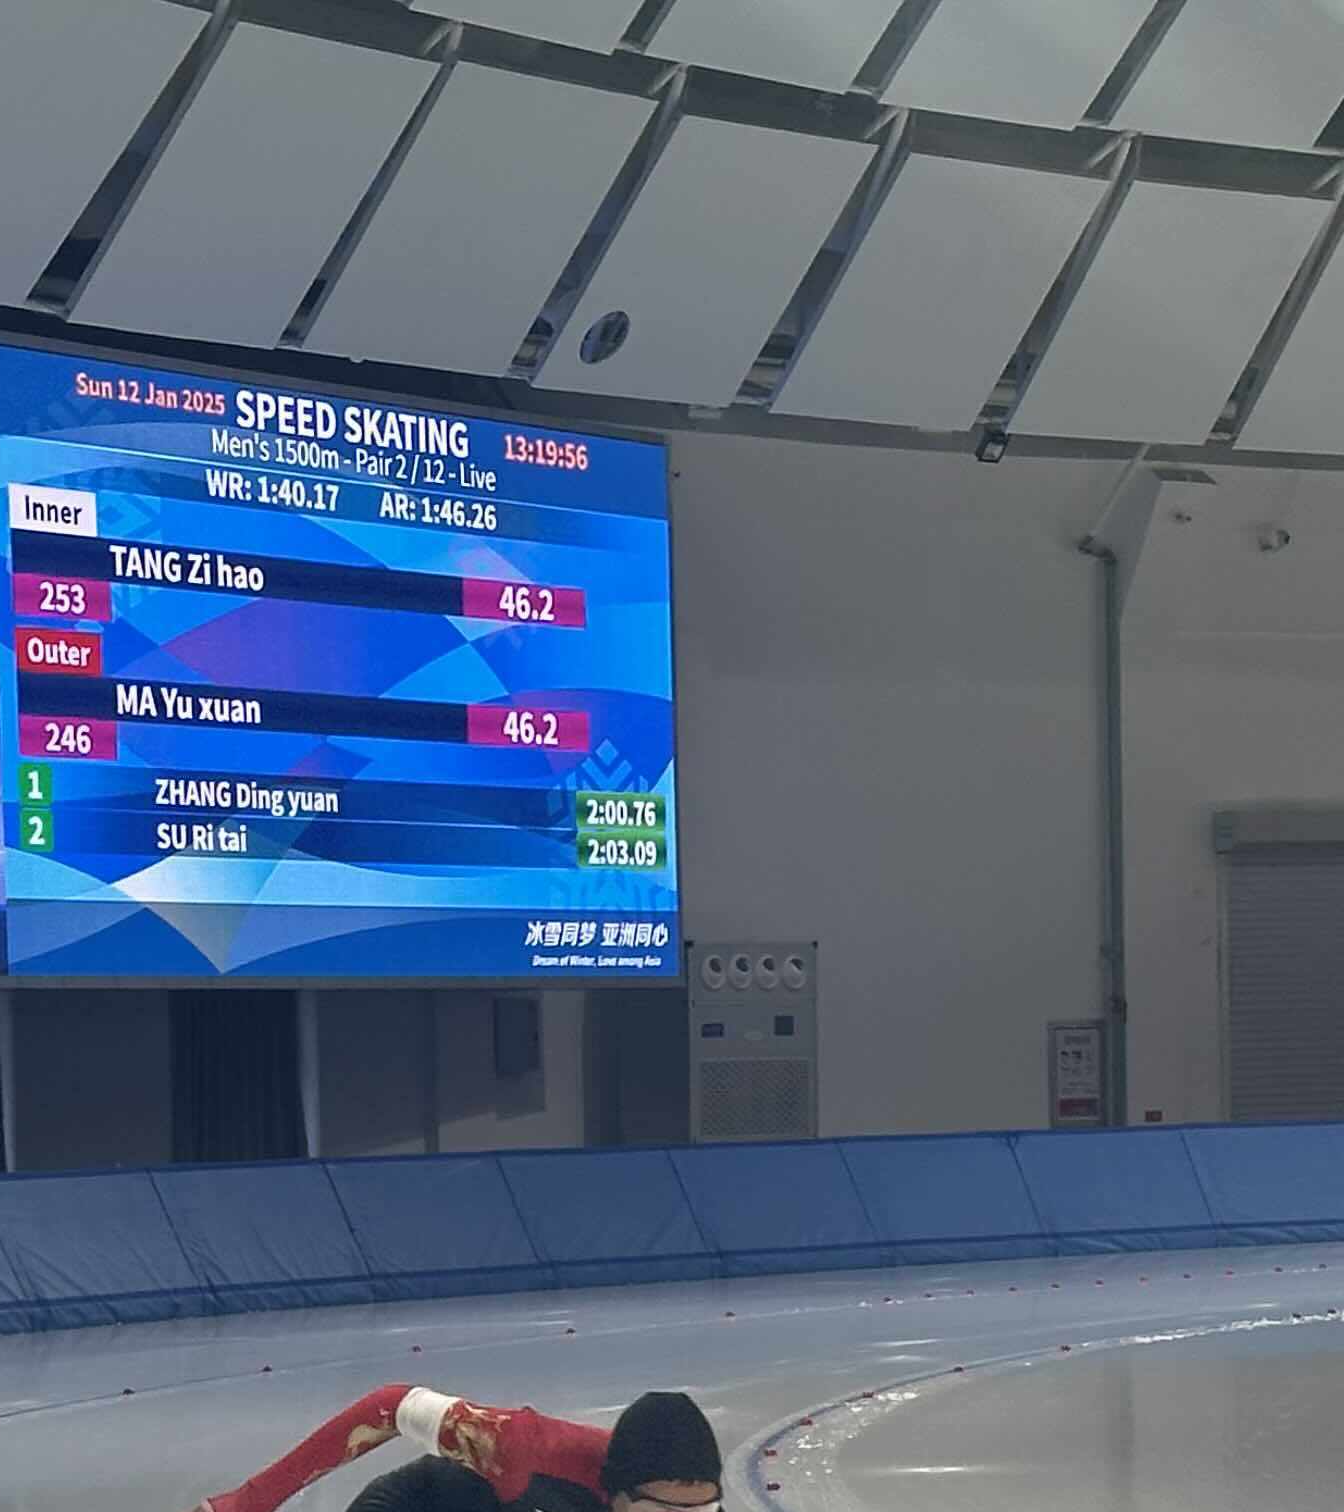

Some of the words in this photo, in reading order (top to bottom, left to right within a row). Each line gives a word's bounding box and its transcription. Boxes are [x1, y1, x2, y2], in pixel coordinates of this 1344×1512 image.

[75, 372, 113, 399] Sun
[118, 380, 141, 403] 12
[144, 382, 178, 409] Jan
[183, 389, 225, 416] 2025
[236, 389, 337, 440] SPEED
[343, 406, 470, 458] SKATING
[211, 428, 270, 462] Men's
[275, 438, 340, 469] 1500m
[355, 448, 393, 476] Pair
[395, 454, 408, 479] 2
[410, 454, 421, 485] /
[423, 458, 446, 484] 12
[459, 461, 497, 492] Live
[503, 434, 589, 471] 13:19:56
[205, 468, 252, 500] WR:
[256, 476, 340, 512] 1:40.17
[24, 495, 83, 525] Inner
[379, 491, 416, 521] AR:
[421, 496, 497, 531] 1:46.26
[108, 544, 182, 583] TANG
[186, 553, 212, 586] Zi
[217, 554, 265, 591] hao
[39, 581, 86, 615] 253
[499, 585, 555, 621] 46.2
[26, 636, 91, 667] Outer
[115, 683, 157, 718] MA
[159, 687, 193, 719] Yu
[198, 697, 262, 724] xuan
[44, 723, 92, 754] 246
[503, 711, 558, 745] 46.2
[27, 770, 43, 799] 1
[155, 778, 232, 808] ZHANG
[236, 782, 284, 817] Ding
[288, 790, 339, 817] yuan
[586, 799, 657, 827] 2:00.76
[28, 816, 46, 846] 2
[156, 823, 188, 850] SU
[192, 823, 214, 851] Ri
[218, 824, 248, 852] tai
[588, 839, 658, 866] 2:03.09
[525, 920, 597, 948] 冰雪同梦
[600, 922, 669, 948] 亚洲同心
